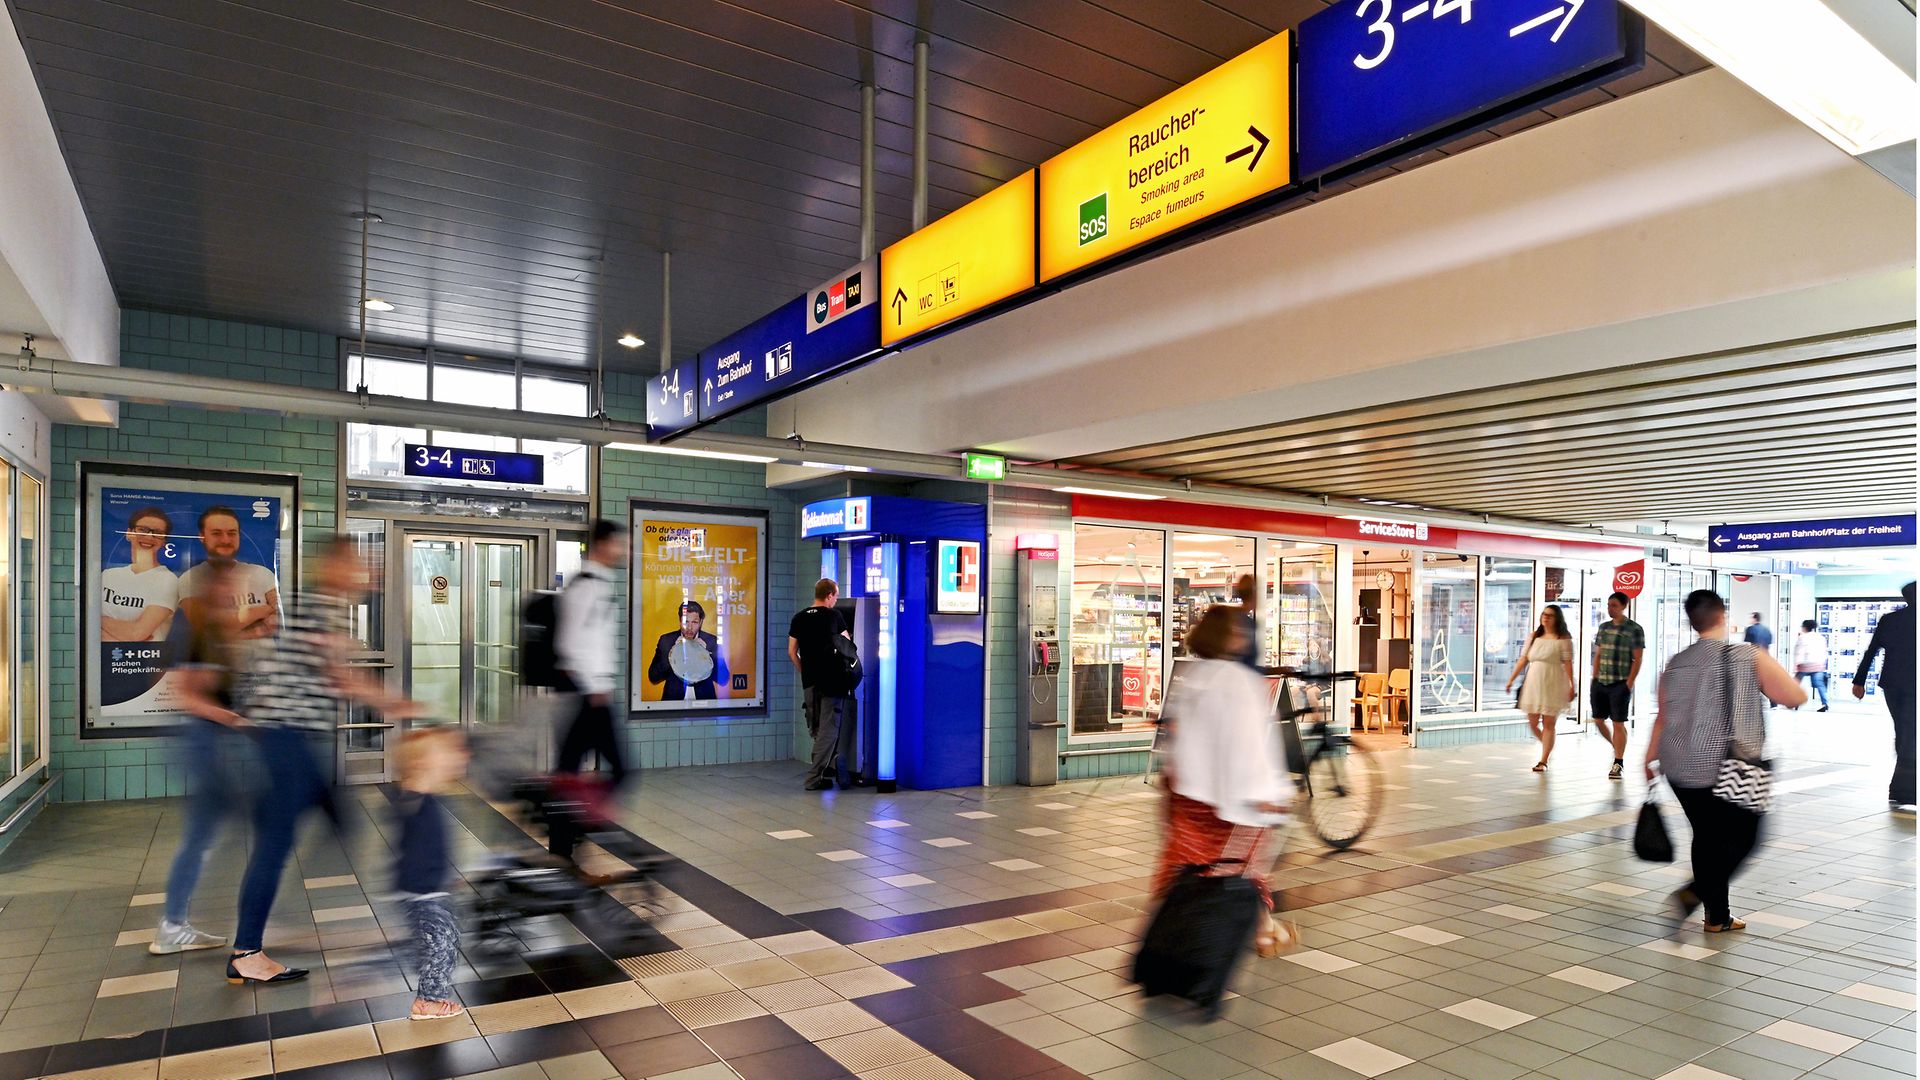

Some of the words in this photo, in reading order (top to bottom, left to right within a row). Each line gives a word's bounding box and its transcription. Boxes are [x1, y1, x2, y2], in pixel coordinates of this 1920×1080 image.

[1129, 107, 1206, 157] Raucher-
[1129, 144, 1189, 189] bereich
[1140, 178, 1180, 204] Smoking
[1182, 168, 1205, 186] area
[1129, 207, 1161, 230] Espace
[1165, 190, 1205, 215] fumeurs
[1080, 214, 1106, 240] SOS
[816, 300, 827, 314] Bus
[830, 293, 844, 306] Tram
[847, 283, 860, 298] TAXI
[919, 293, 933, 310] WC
[717, 351, 740, 370] Ausgang
[717, 373, 730, 387] Zum
[729, 360, 752, 381] Bahnhof
[660, 368, 680, 405] 3-4
[415, 446, 453, 469] 3-4
[645, 525, 657, 533] Ob
[658, 527, 676, 535] du's
[1359, 521, 1415, 538] ServiceStore
[1737, 532, 1771, 541] Ausgang
[1773, 531, 1790, 539] zum
[1792, 528, 1850, 538] Bahnhof/Platz
[1851, 526, 1866, 535] der
[1868, 525, 1902, 534] Freiheit
[658, 545, 691, 562] DIE
[695, 546, 747, 564] WELT
[645, 562, 681, 572] können
[682, 563, 695, 572] wir
[701, 563, 723, 573] nicht
[658, 573, 741, 586] verbessern.
[103, 587, 145, 609] Team
[137, 649, 161, 659] ICH
[111, 667, 163, 675] Pflegekräfte.
